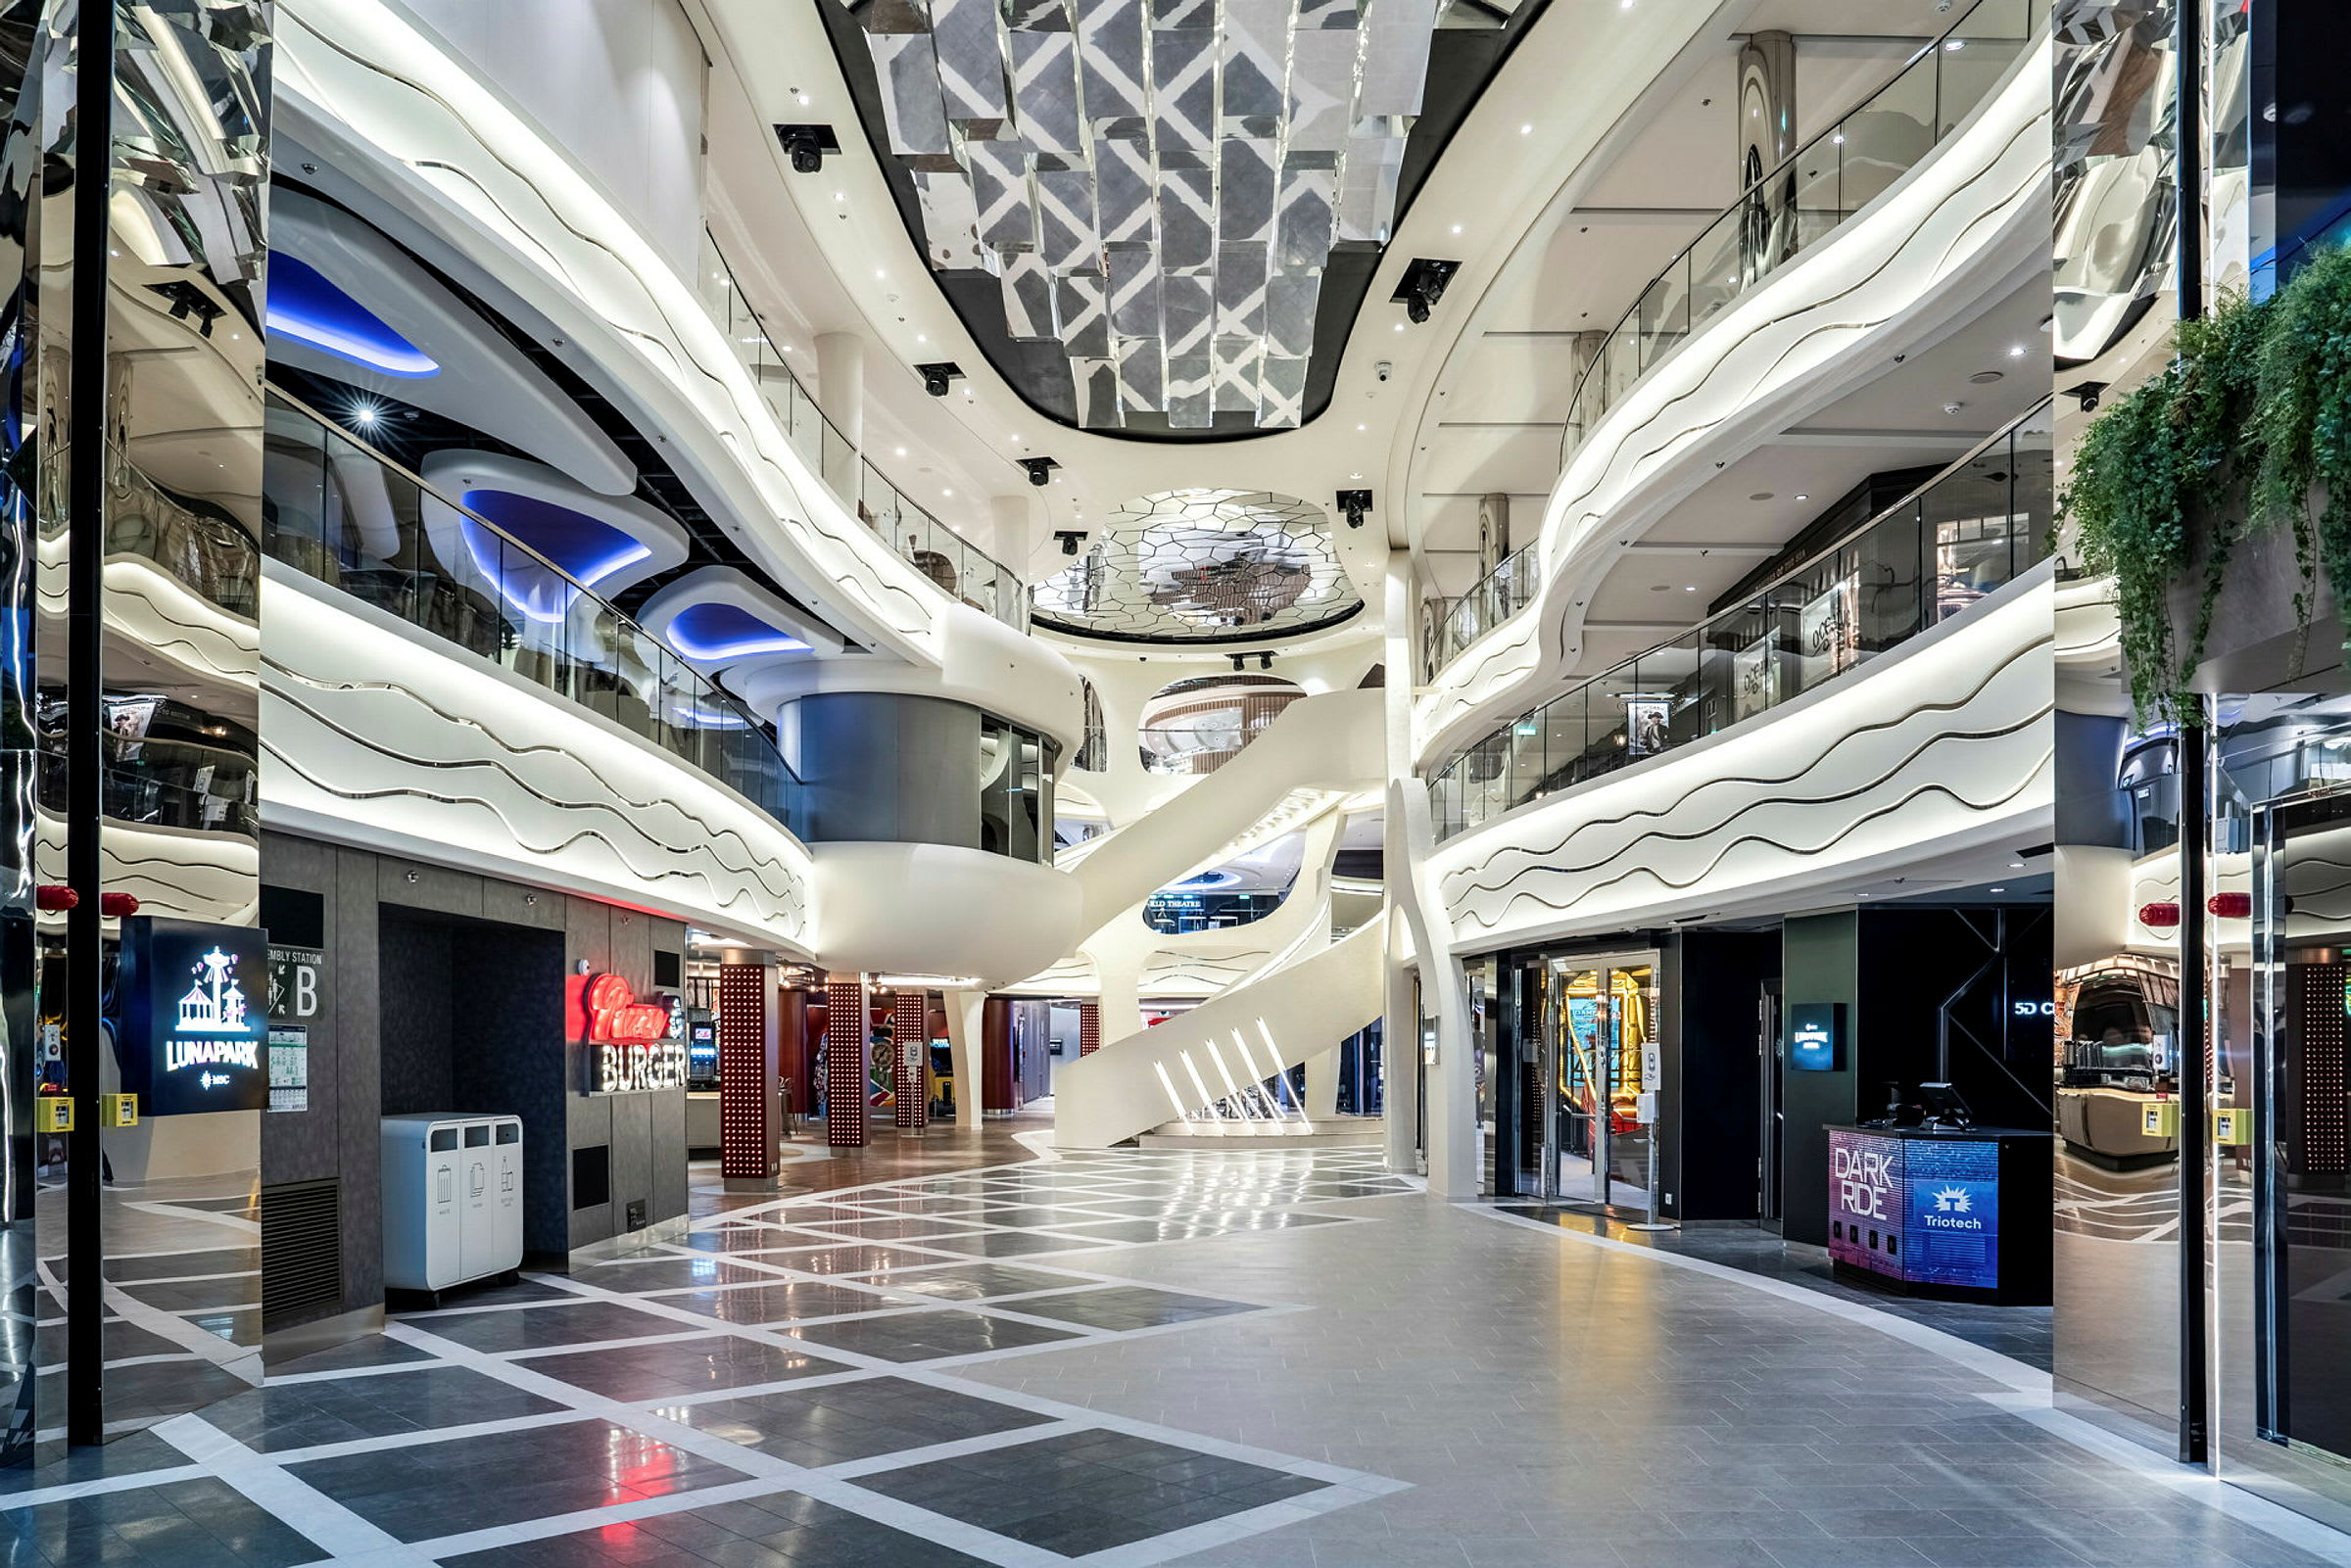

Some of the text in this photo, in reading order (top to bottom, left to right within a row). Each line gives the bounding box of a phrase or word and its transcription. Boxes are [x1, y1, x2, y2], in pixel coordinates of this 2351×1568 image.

[292, 951, 322, 965] STATION
[297, 965, 317, 1016] B
[2014, 1002, 2037, 1015] 5D
[166, 1040, 259, 1071] LUNAPARK
[602, 1043, 686, 1092] BURGER
[212, 1074, 230, 1085] MSC
[1835, 1147, 1894, 1188] DARK
[1923, 1214, 1982, 1230] Triotech
